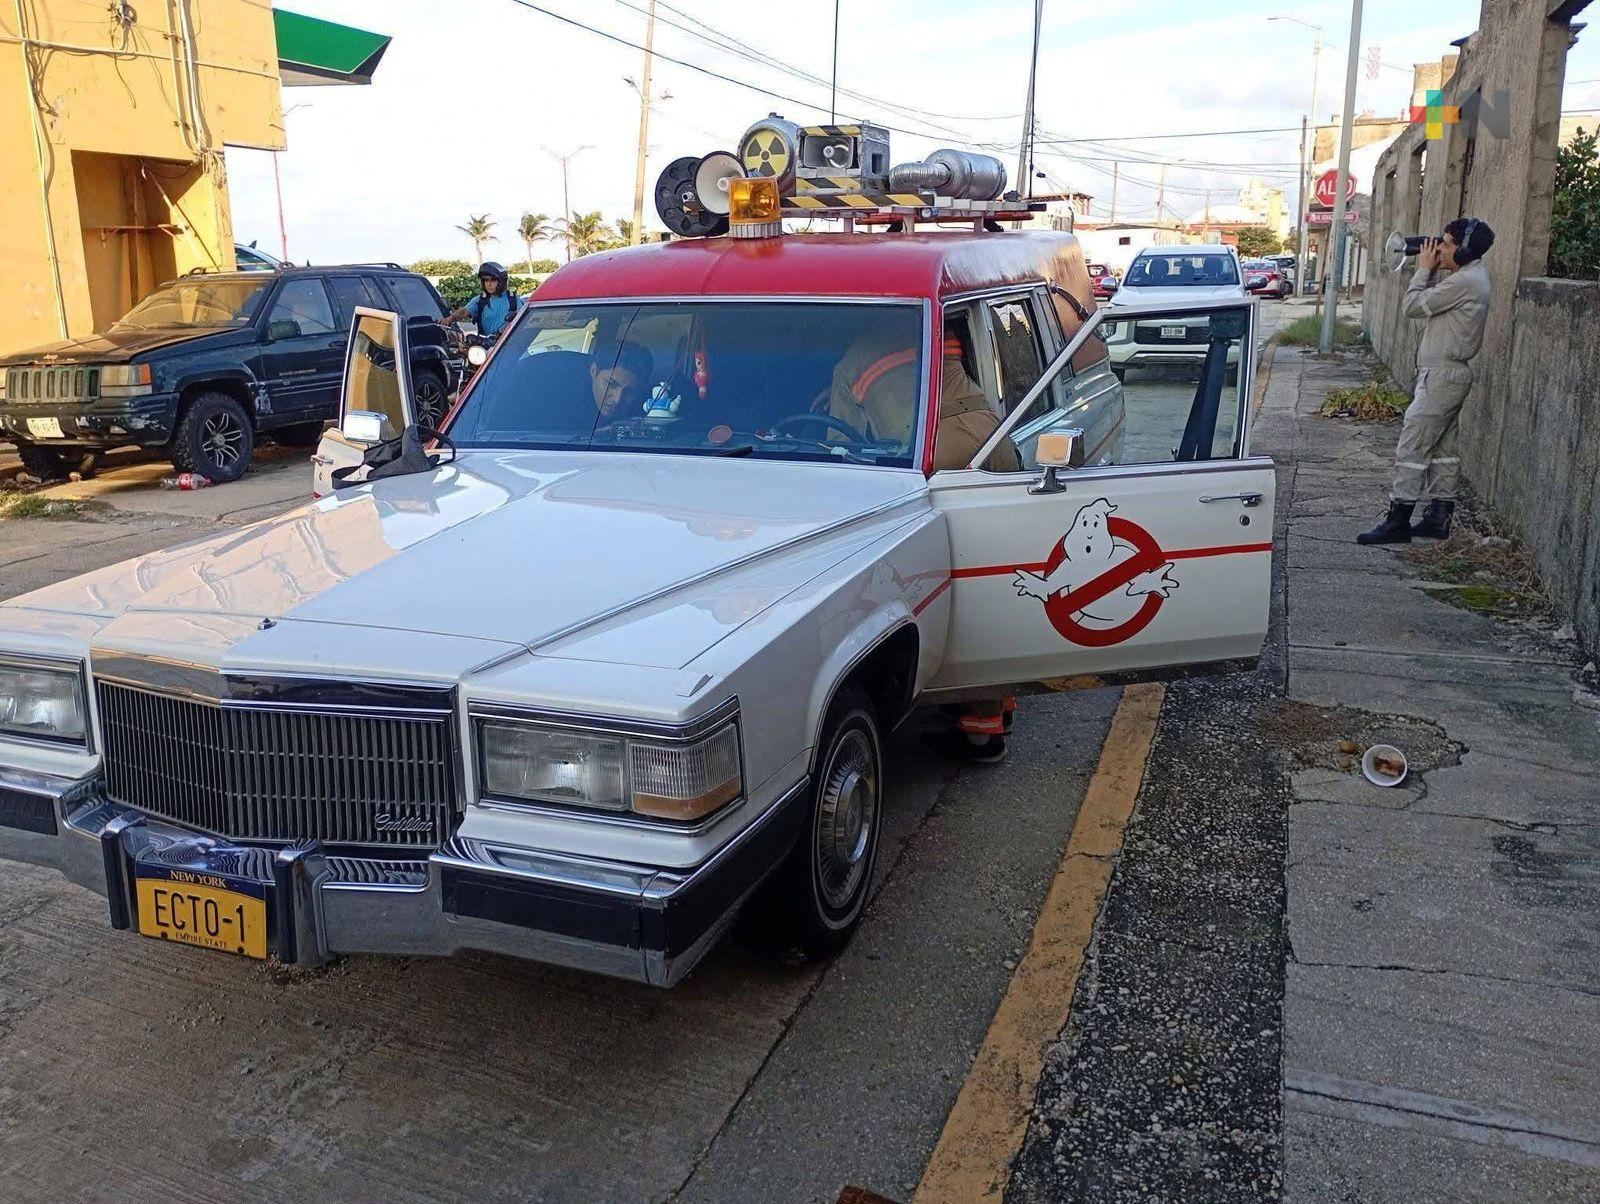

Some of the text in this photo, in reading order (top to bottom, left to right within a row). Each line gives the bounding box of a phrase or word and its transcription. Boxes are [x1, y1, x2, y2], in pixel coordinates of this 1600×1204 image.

[374, 813, 433, 831] Cadillac
[170, 870, 227, 888] NEW YORK
[154, 888, 245, 943] ECTO-1
[175, 932, 227, 949] EMPIRE STATE
